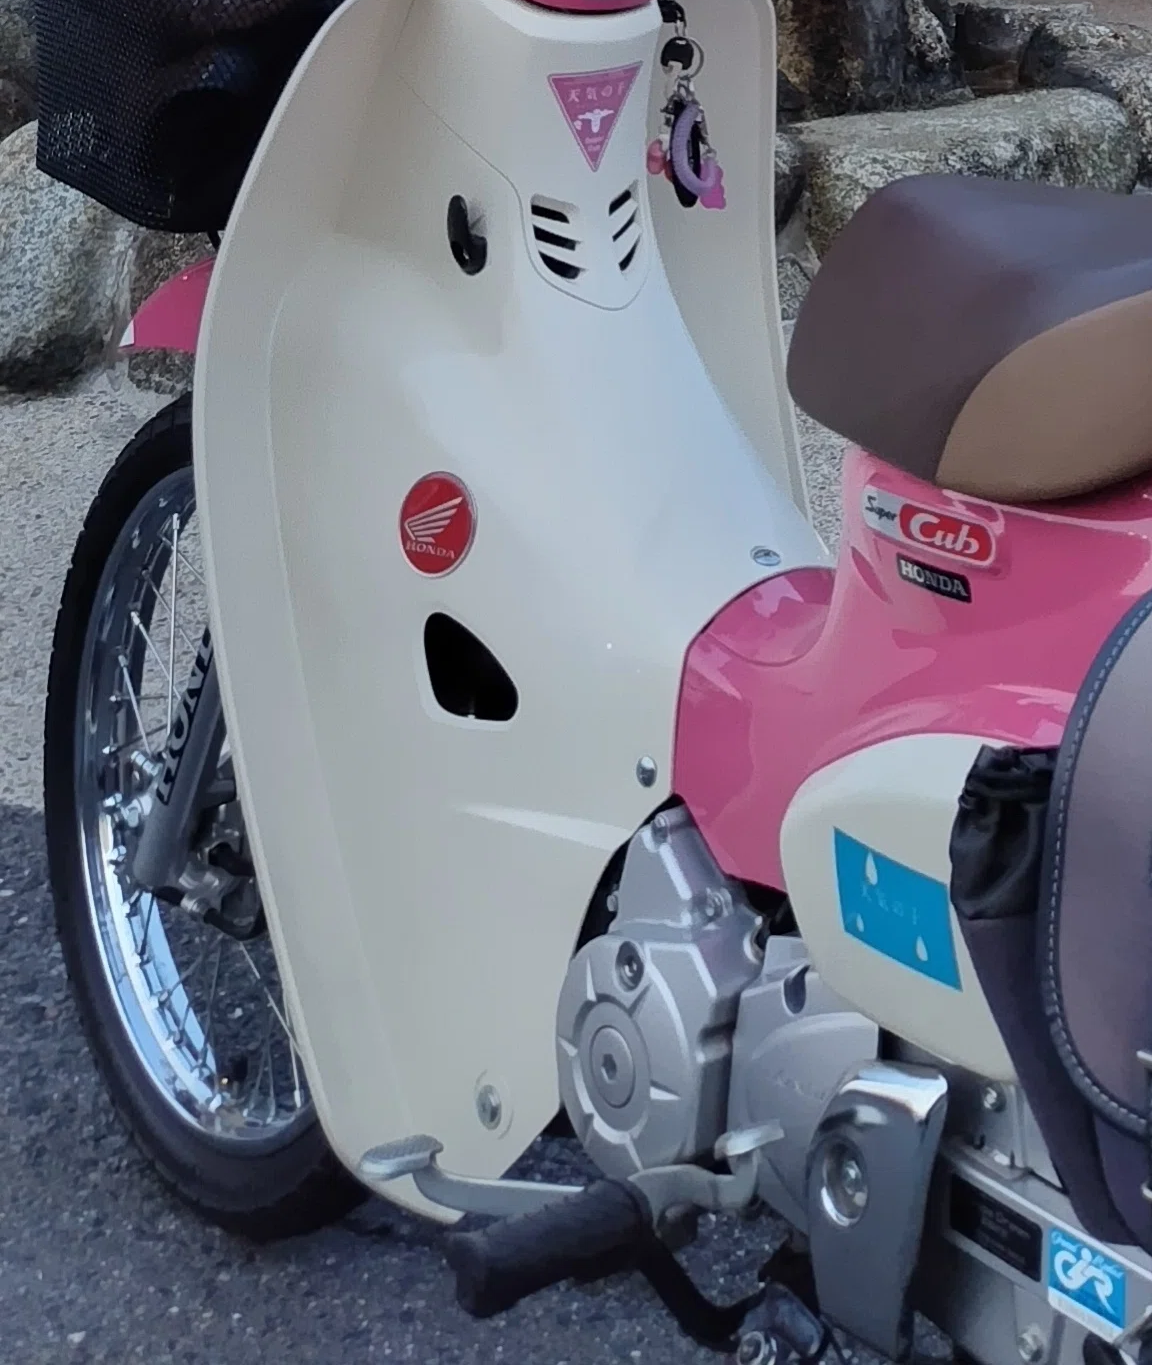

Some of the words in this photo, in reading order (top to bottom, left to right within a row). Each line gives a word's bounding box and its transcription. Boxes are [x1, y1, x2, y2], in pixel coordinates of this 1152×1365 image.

[865, 494, 897, 521] Super
[909, 512, 980, 555] Cub
[405, 539, 456, 560] HONDA
[899, 558, 968, 597] HONDA
